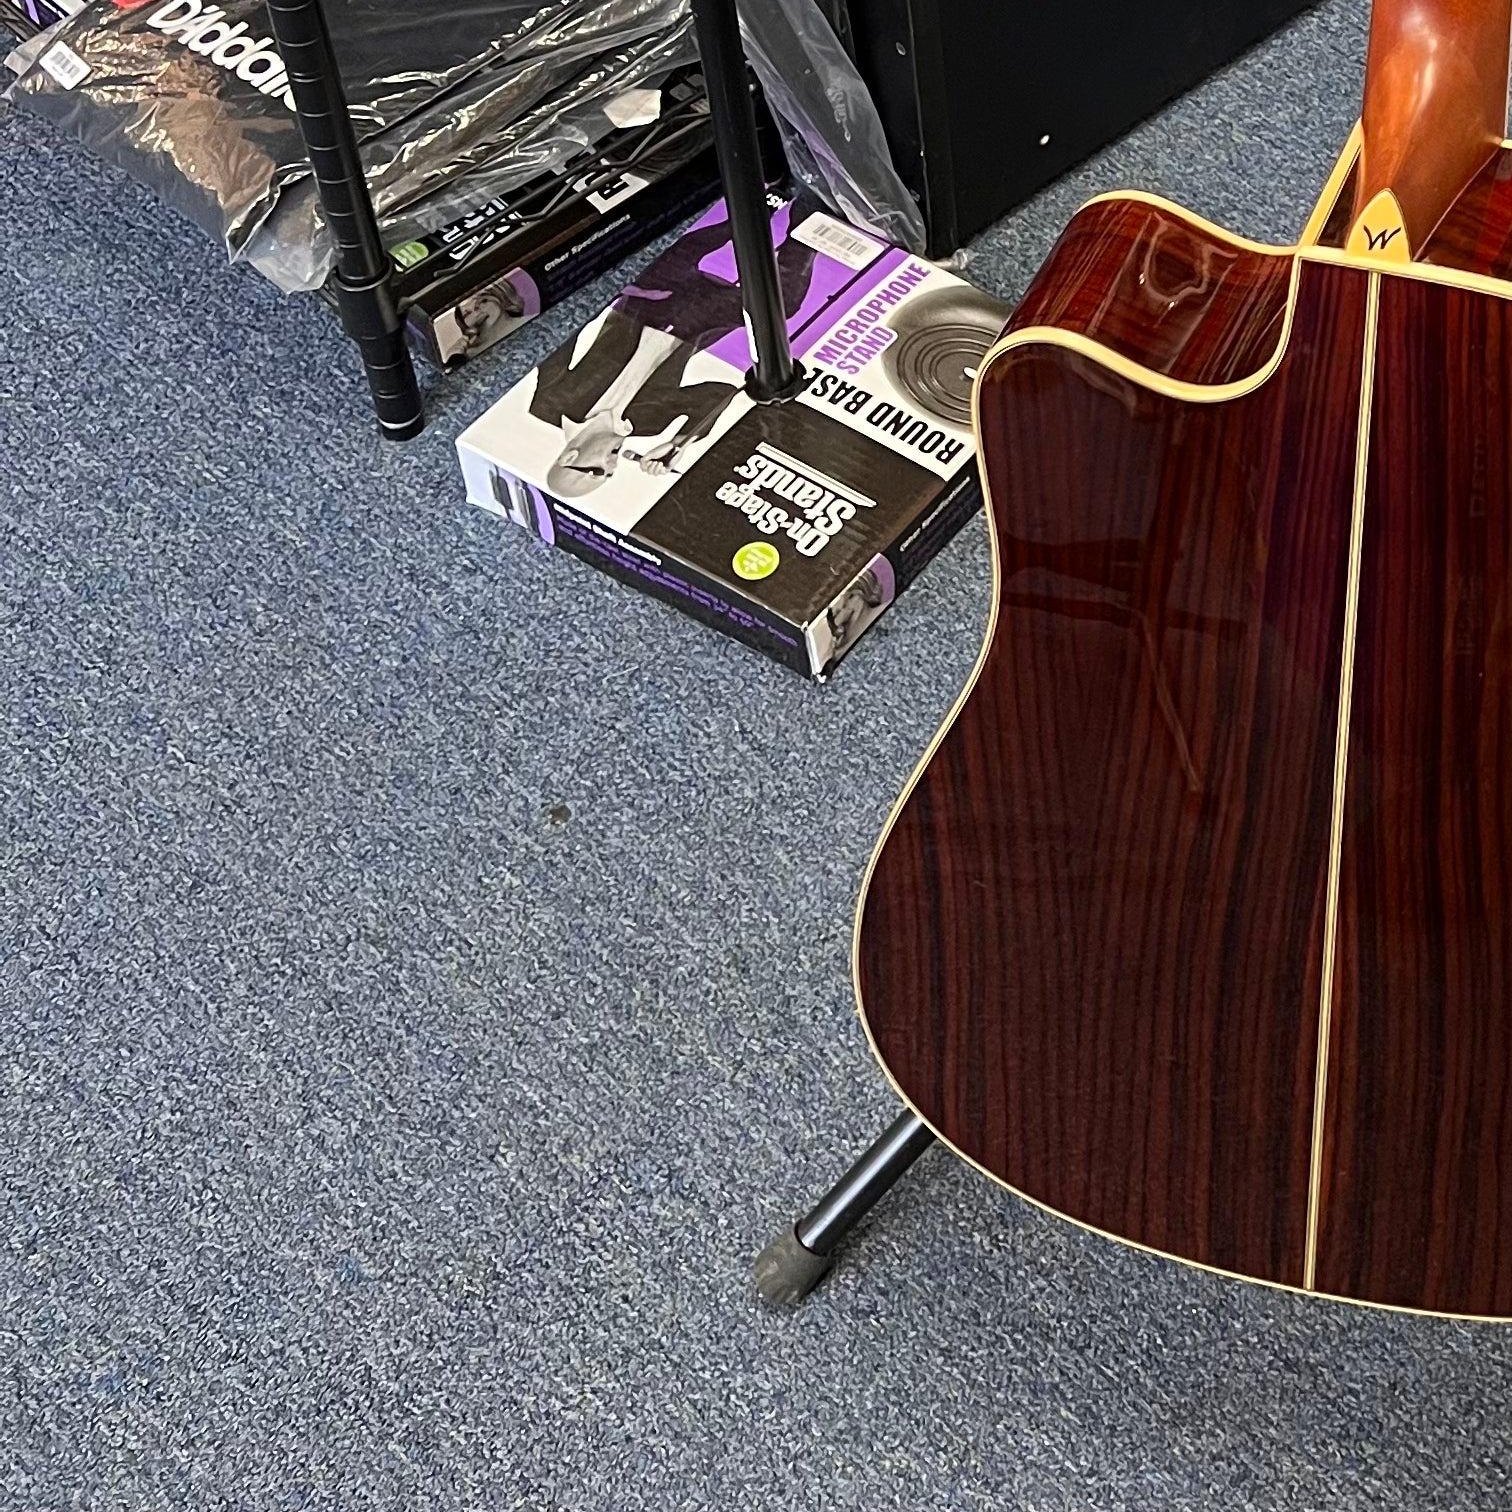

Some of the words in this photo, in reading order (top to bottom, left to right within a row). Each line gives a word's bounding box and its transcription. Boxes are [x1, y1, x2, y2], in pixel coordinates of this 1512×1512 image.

[814, 262, 931, 366] MICROPHONE
[836, 325, 895, 376] STAND
[867, 401, 965, 465] ROUND
[716, 480, 830, 557] On-Stage
[733, 454, 856, 537] Stands
